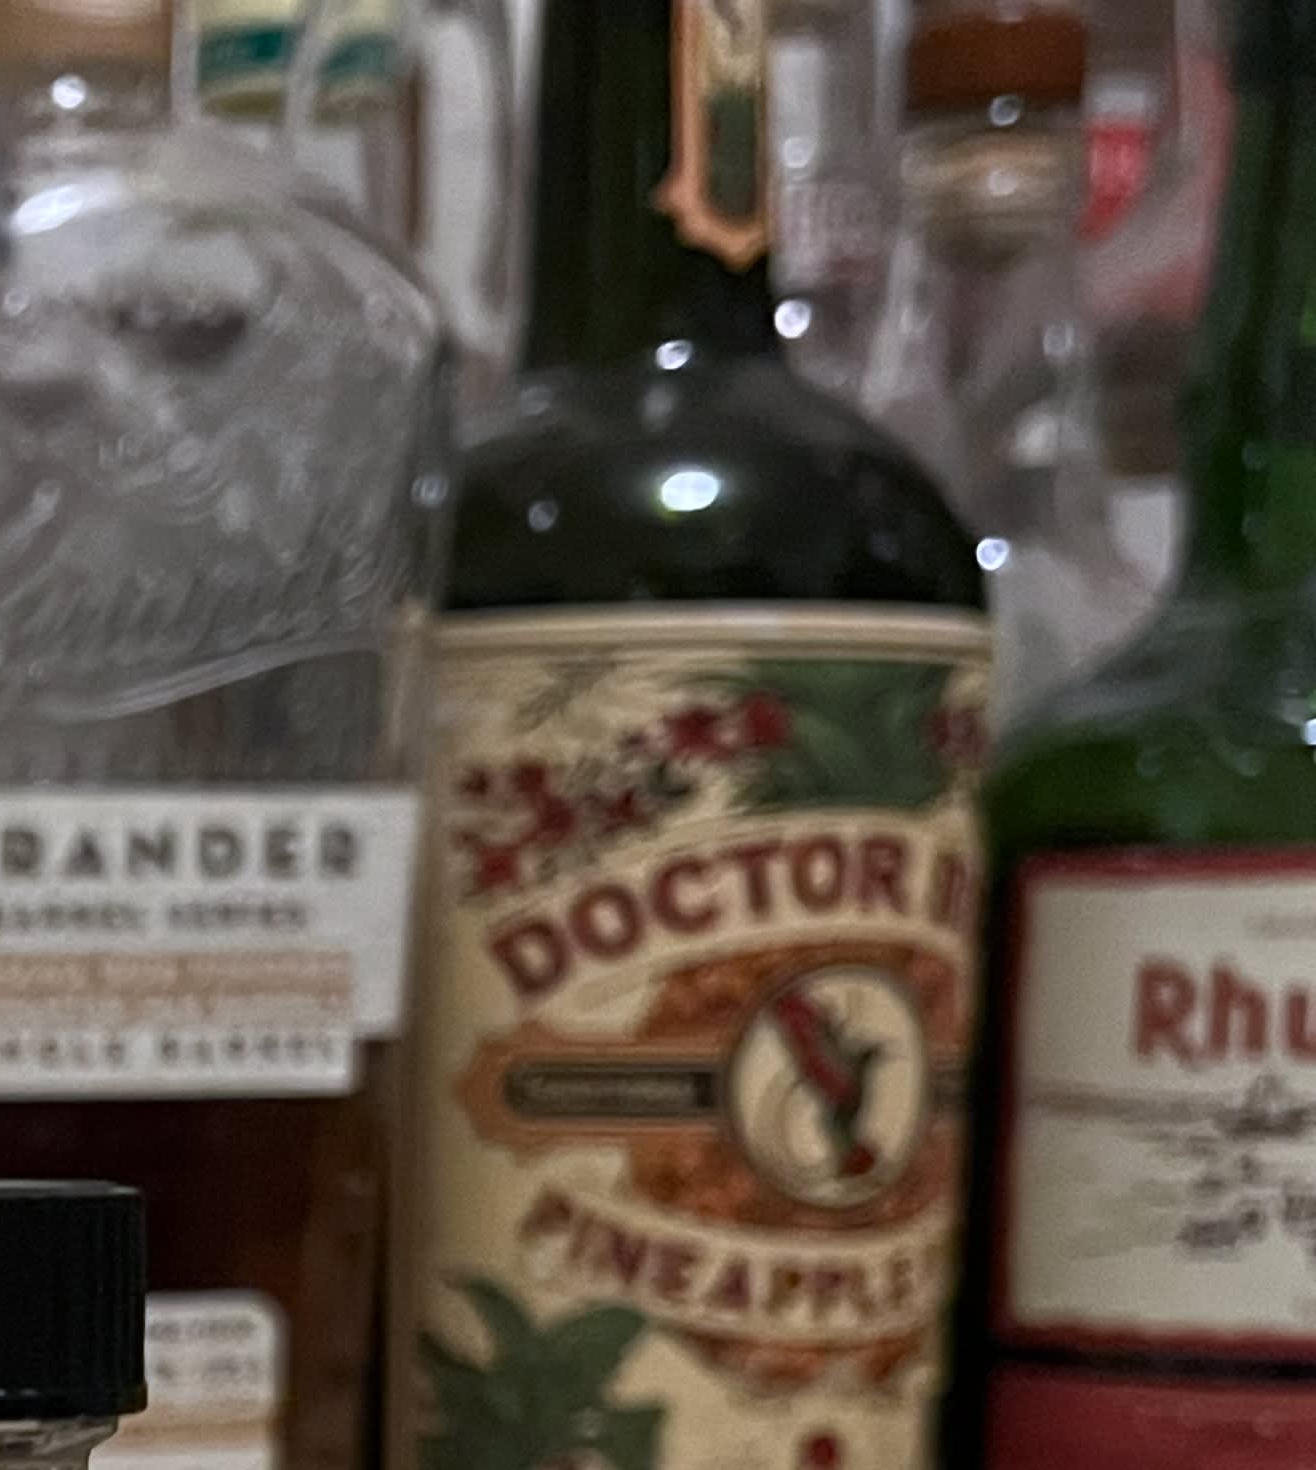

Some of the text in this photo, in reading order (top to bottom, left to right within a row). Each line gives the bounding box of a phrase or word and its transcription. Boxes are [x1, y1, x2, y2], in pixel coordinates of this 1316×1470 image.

[487, 832, 913, 1000] DOCTOR
[1131, 955, 1316, 1070] Rhu
[517, 1188, 917, 1316] PINEAPPLE
